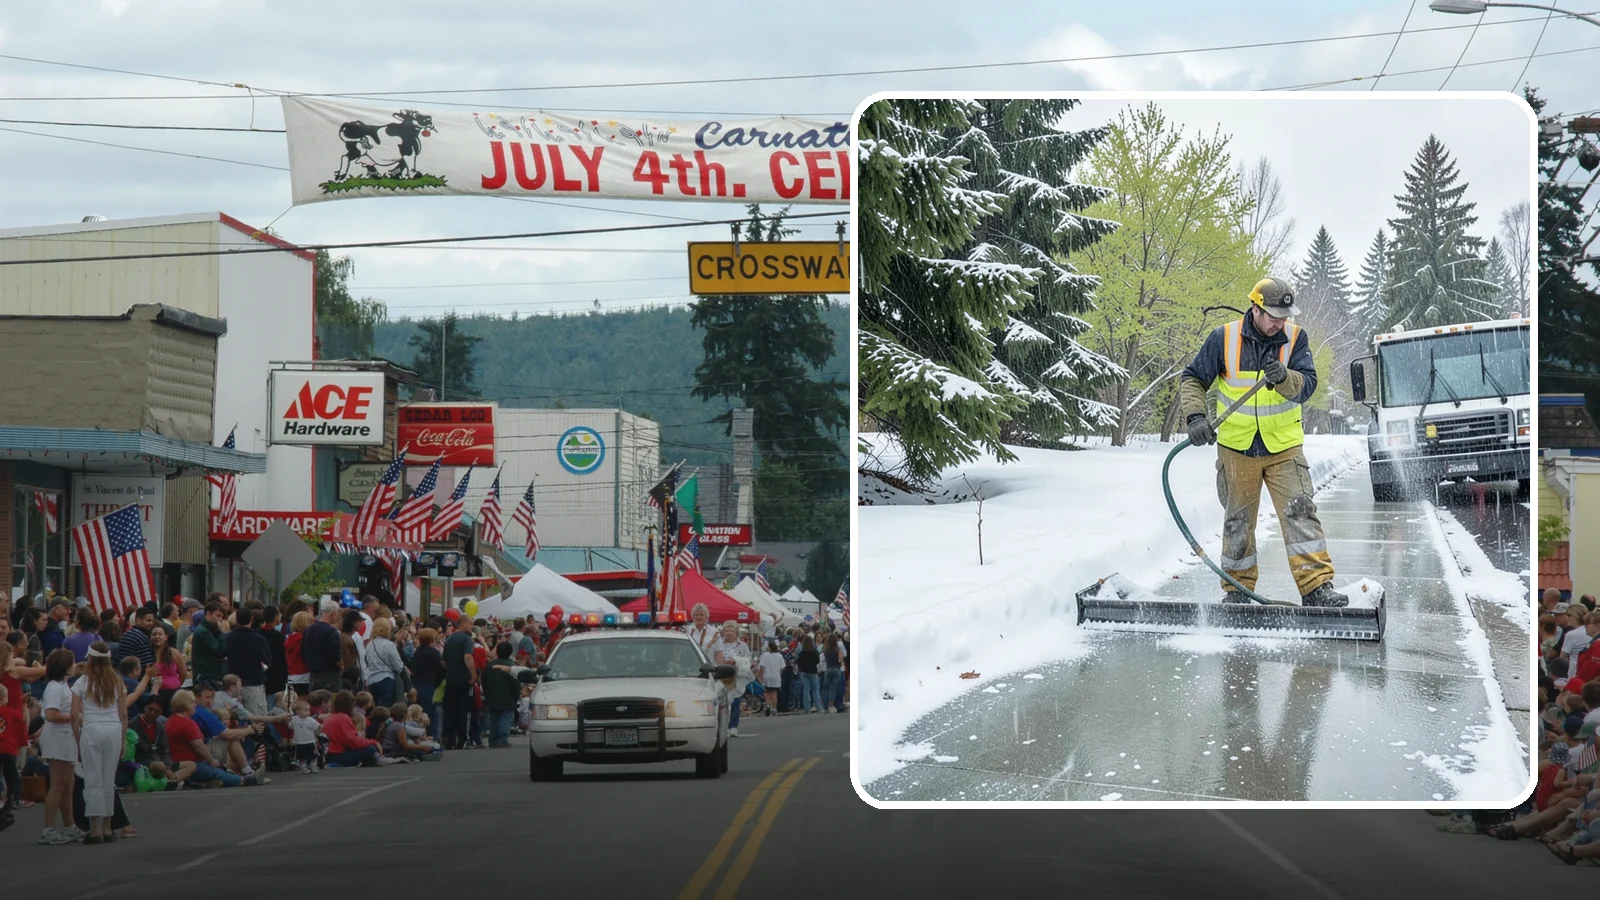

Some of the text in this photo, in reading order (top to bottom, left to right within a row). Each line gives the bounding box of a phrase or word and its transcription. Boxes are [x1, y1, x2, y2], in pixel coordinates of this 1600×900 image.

[481, 141, 605, 192] JULY
[632, 150, 747, 198] 4th.
[696, 254, 850, 280] CROSSWA
[282, 380, 373, 420] ACE
[405, 409, 485, 422] CEDAR LOG
[283, 421, 371, 437] Hardware
[416, 428, 477, 447] Coca-Cola
[83, 485, 155, 495] St. Vincent de Paul
[688, 526, 741, 535] CRNATION
[699, 535, 730, 543] GLASS
